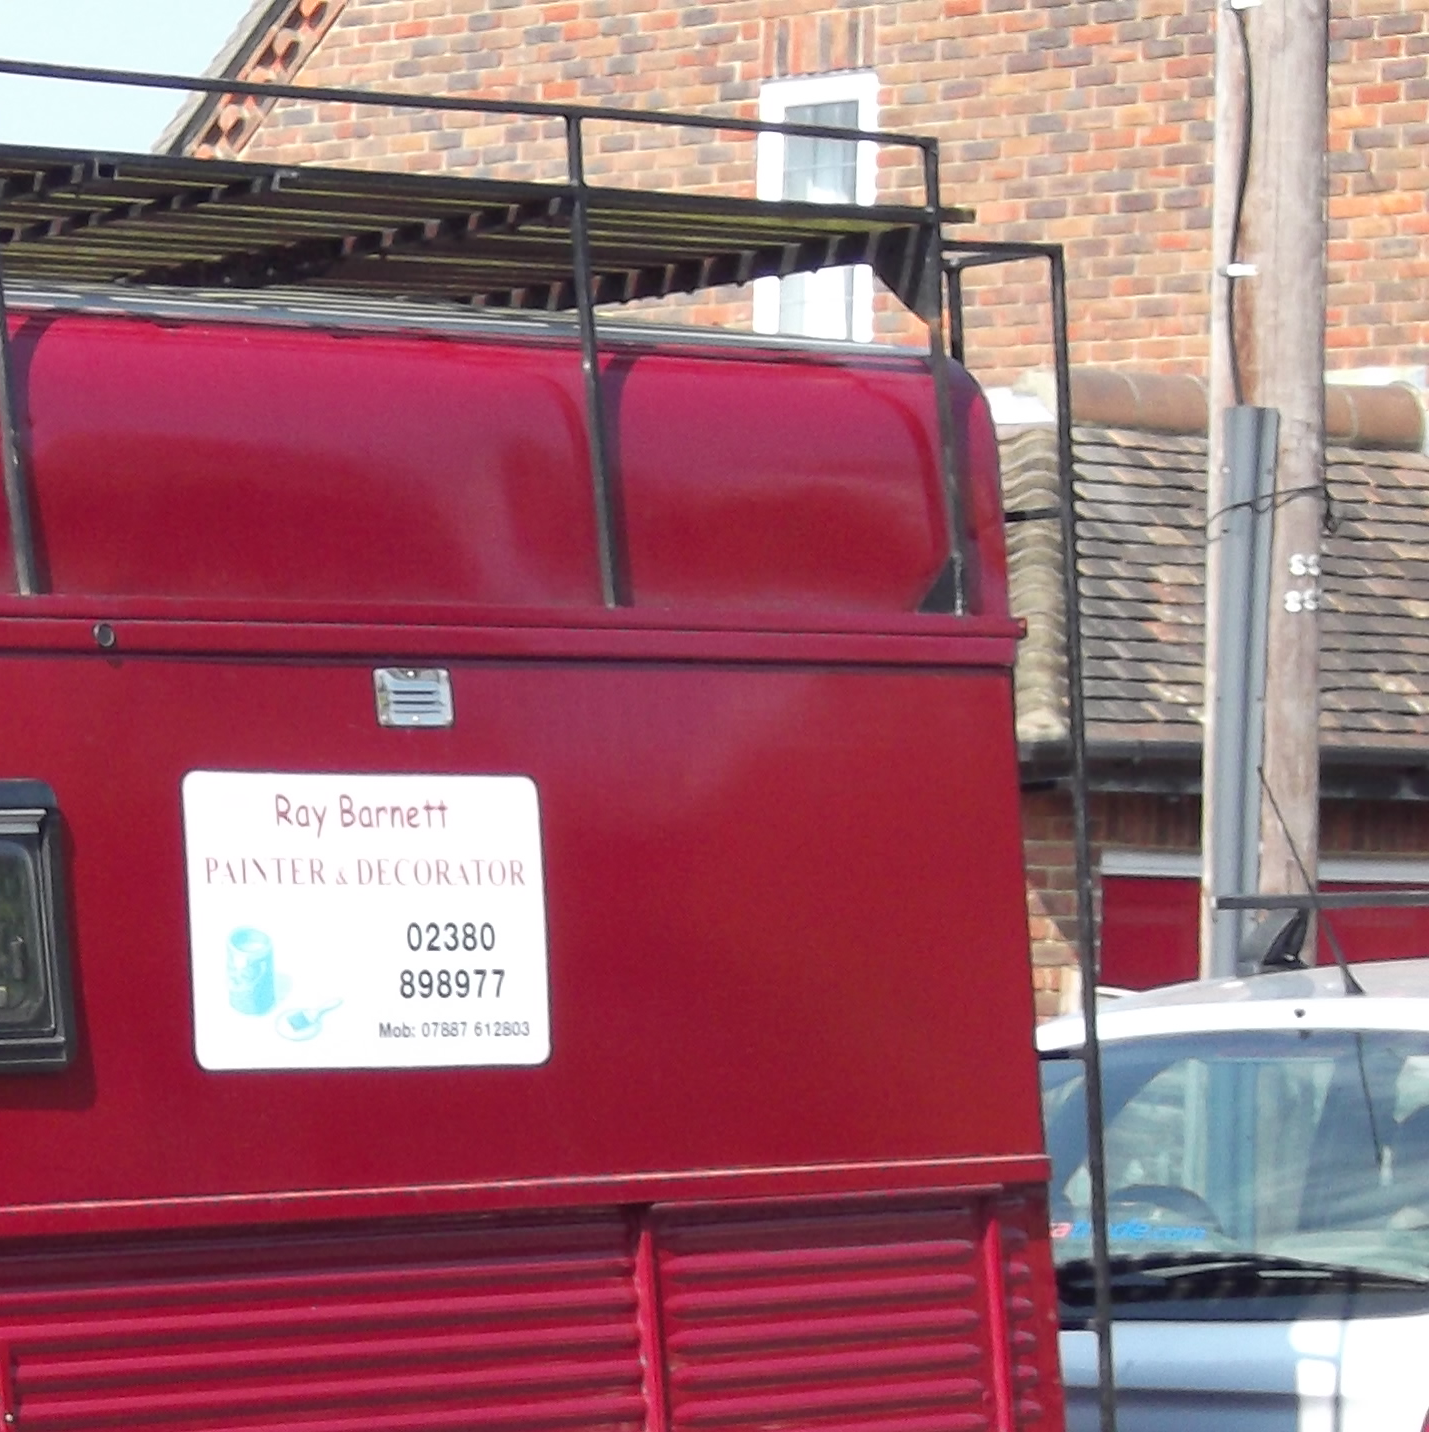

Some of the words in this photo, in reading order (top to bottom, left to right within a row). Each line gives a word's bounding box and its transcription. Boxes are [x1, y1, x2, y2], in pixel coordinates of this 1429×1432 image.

[274, 793, 328, 839] Ray
[339, 793, 449, 829] Barnett
[204, 856, 327, 885] PAINTER
[335, 865, 349, 886] &
[357, 857, 526, 886] DECORATOR
[406, 921, 496, 952] 02380
[399, 968, 506, 999] 898977
[378, 1021, 416, 1038] Mob:
[421, 1021, 468, 1038] 07887
[473, 1020, 531, 1037] 612803
